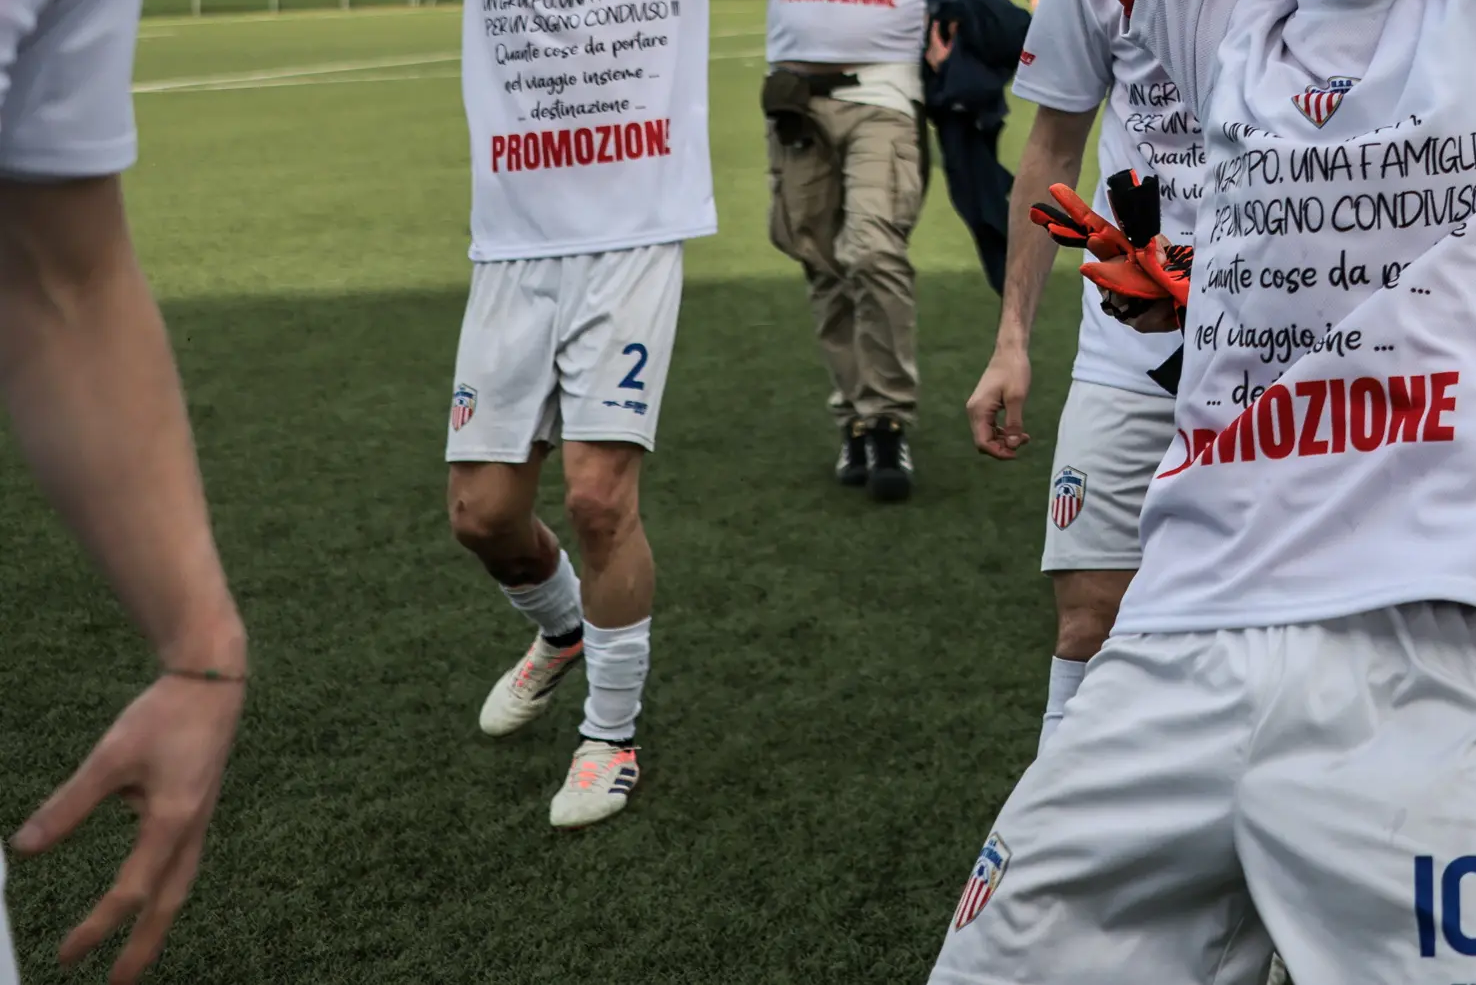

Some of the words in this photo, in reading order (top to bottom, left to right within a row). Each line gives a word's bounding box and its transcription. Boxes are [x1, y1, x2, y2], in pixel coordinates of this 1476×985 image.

[530, 14, 580, 34] SOGNO
[584, 1, 669, 27] CONDIVISO
[495, 41, 540, 65] Quante
[544, 44, 579, 60] cose
[584, 35, 605, 55] da
[612, 31, 668, 58] portare
[526, 74, 577, 96] viaggio
[582, 67, 643, 86] insieme
[530, 98, 630, 121] destinazione
[1161, 111, 1188, 134] UN
[1290, 145, 1352, 183] UNA
[1244, 197, 1324, 236] SOGNO
[1259, 265, 1317, 294] cose
[1328, 250, 1370, 291] da
[1194, 312, 1225, 351] nel
[1227, 323, 1315, 363] viaggio
[618, 343, 648, 391] 2
